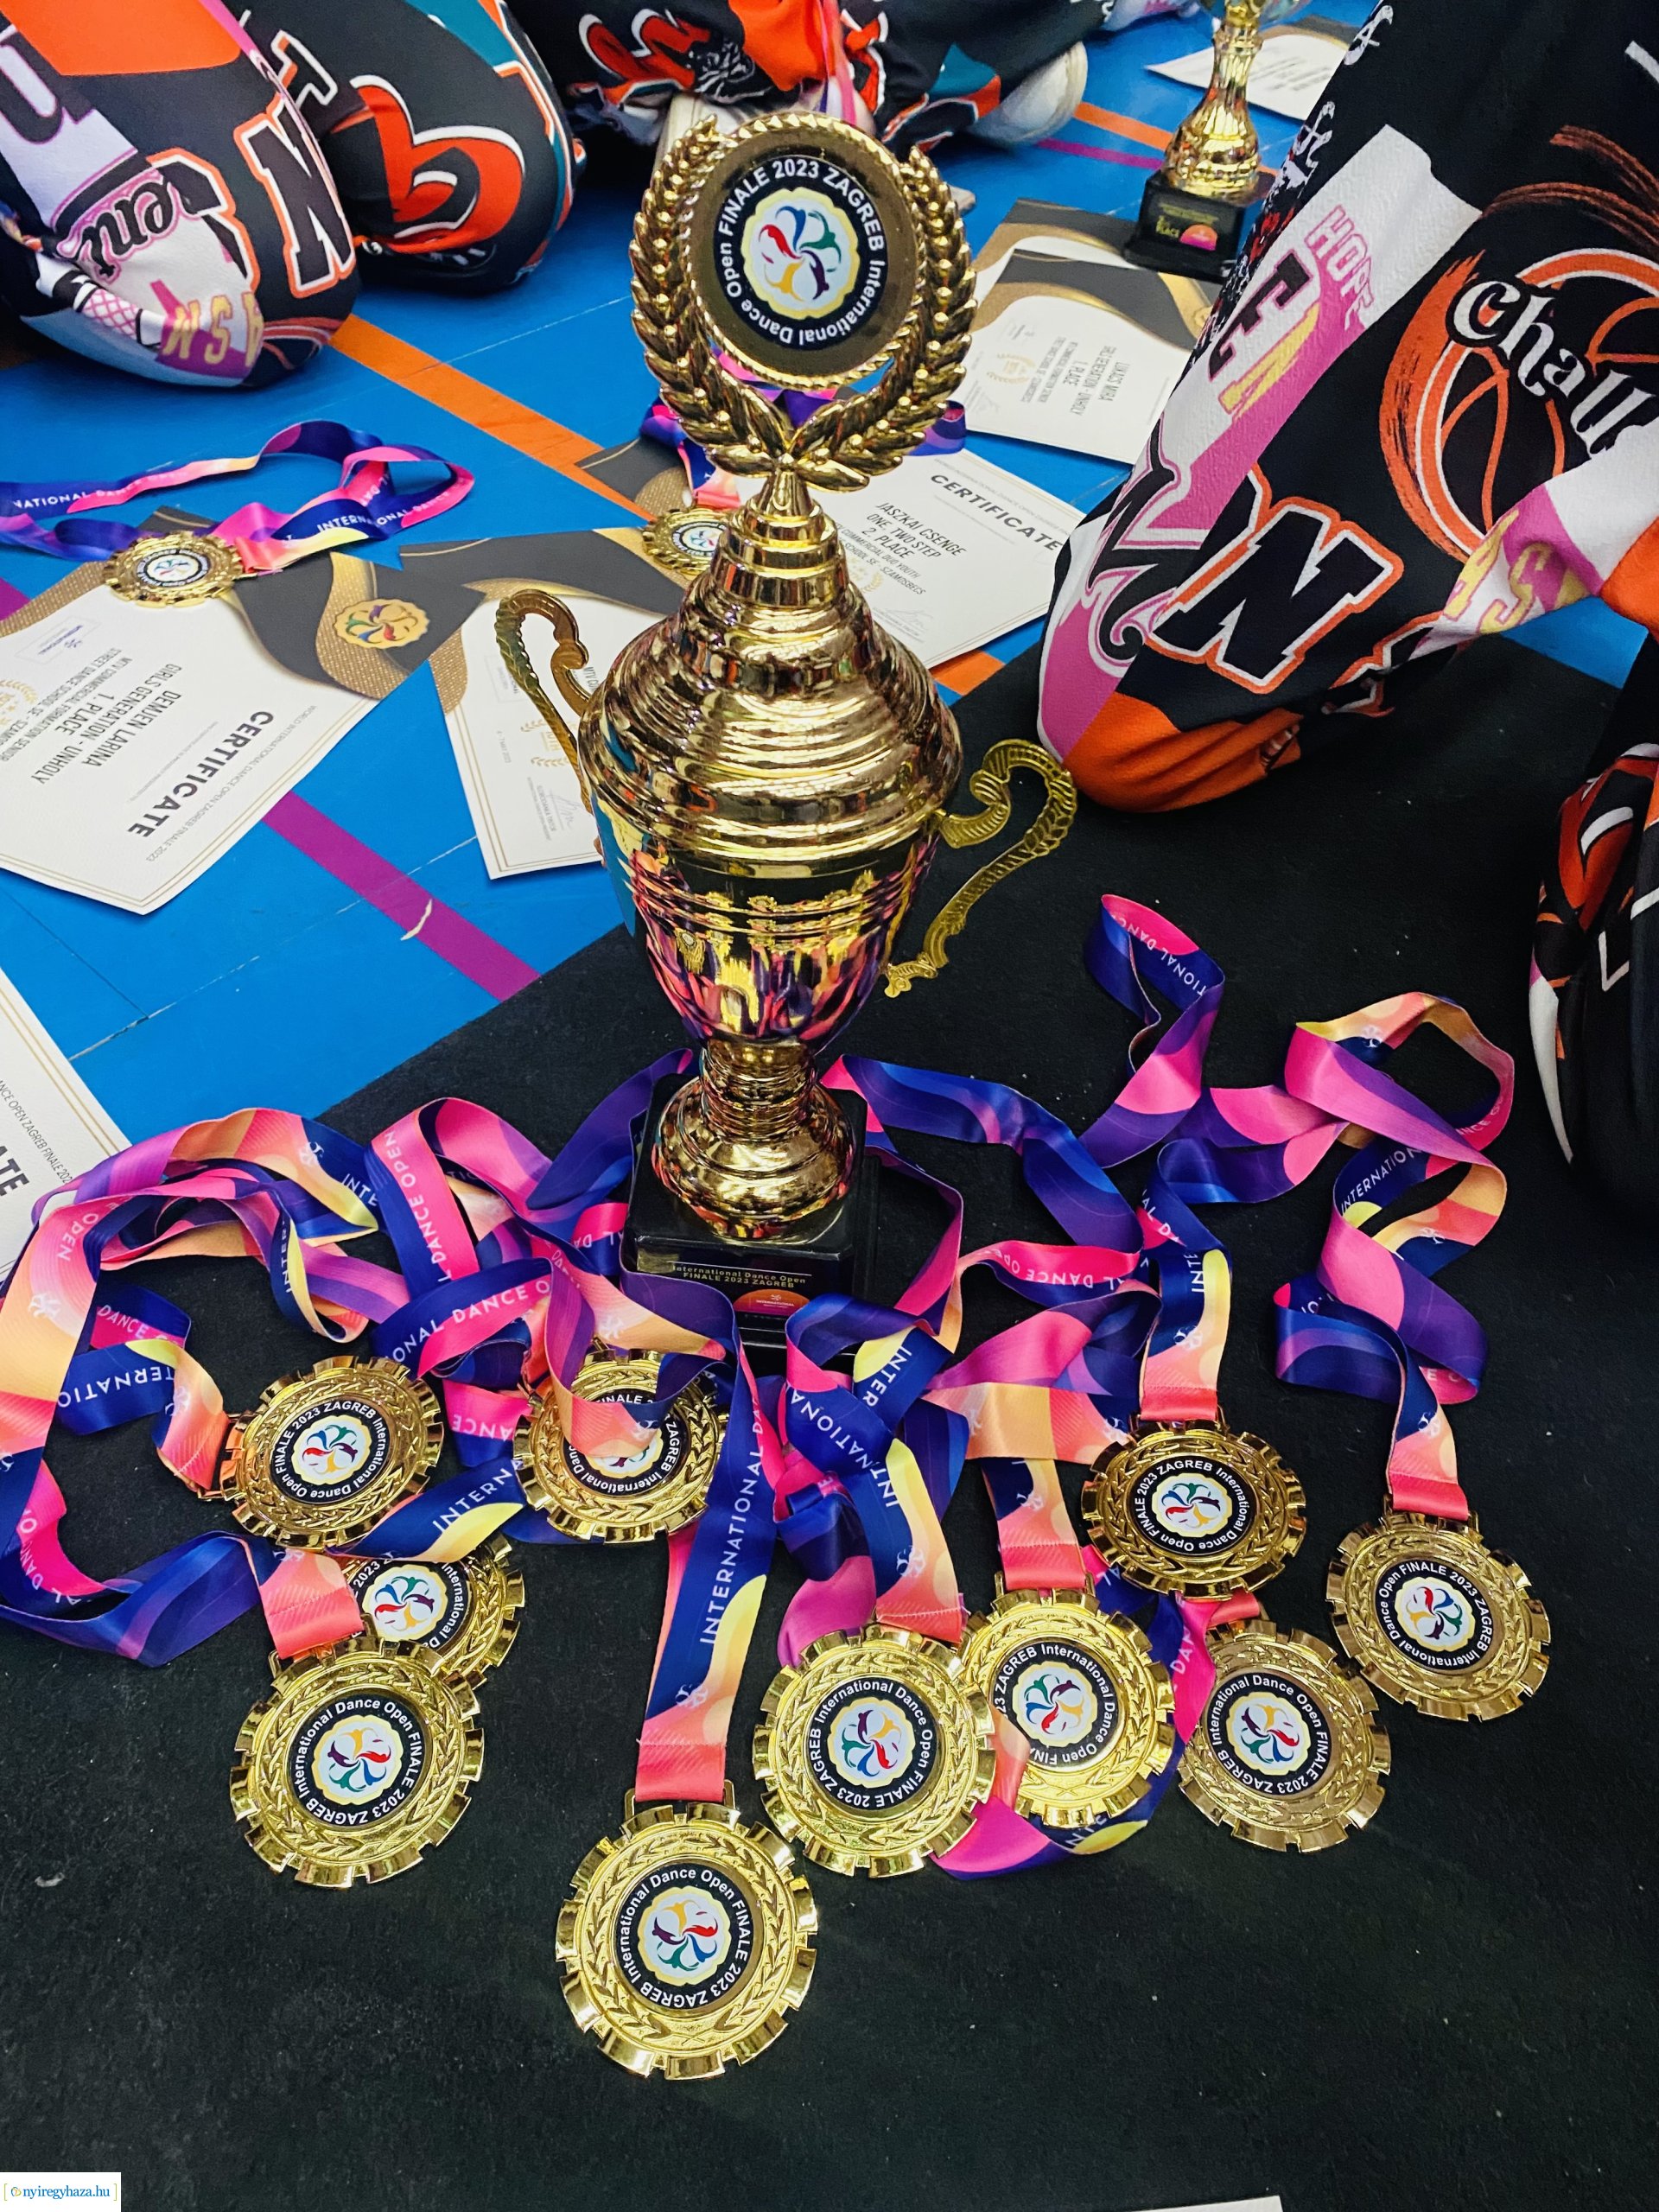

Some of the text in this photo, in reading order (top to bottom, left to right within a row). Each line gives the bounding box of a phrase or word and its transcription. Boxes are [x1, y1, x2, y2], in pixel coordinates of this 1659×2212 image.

[718, 158, 885, 346] International Dance Open FINALE 2023 ZAGREB
[931, 474, 1063, 550] CERTIFICATE
[874, 535, 915, 559] PLACE
[891, 527, 913, 543] TWO
[912, 541, 942, 558] STEP
[919, 528, 967, 556] CSENGE
[31, 663, 183, 785] GIRLS GENERATION UNHOLY
[54, 702, 103, 736] PLACE
[81, 728, 137, 767] LARINA
[127, 711, 274, 837] CERTIFICATE
[9, 1100, 28, 1122] OPEN
[22, 1119, 48, 1149] ZAGREB
[41, 1147, 64, 1172] FINALE
[385, 1130, 448, 1264] DANCE OPEN
[56, 1212, 99, 1262] OPEN
[683, 1272, 795, 1288] FINALE 2023 ZAGREB
[744, 1272, 777, 1281] Dance
[779, 1274, 806, 1284] Open
[1026, 1268, 1094, 1288] DANCE
[97, 1304, 151, 1339] DANCE
[451, 1284, 529, 1325] DANCE
[275, 1401, 386, 1498] International Dance Open FINALE 2023 ZAGREB
[661, 1421, 680, 1473] ZAGREB
[581, 1471, 662, 1493] International
[1135, 1459, 1249, 1552] International Dance Open FINALE 2023 ZAGREB
[353, 1560, 381, 1588] 2023
[441, 1562, 465, 1639] International
[1379, 1561, 1492, 1667] International Dance Open FINALE 2023 ZAGREB
[995, 1645, 1038, 1694] ZAGREB
[1041, 1643, 1115, 1698] International
[810, 1680, 933, 1808] International Dance Open FINALE 2023 ZAGREB
[1096, 1702, 1116, 1743] Dance
[1209, 1675, 1329, 1794] International Dance Open FINALE 2023 ZAGREB
[294, 1699, 423, 1825] International Dance Open FINALE 2023 ZAGREB
[1061, 1744, 1097, 1763] Open
[620, 1869, 752, 2008] International Dance Open FINALE 2023 ZAGREB
